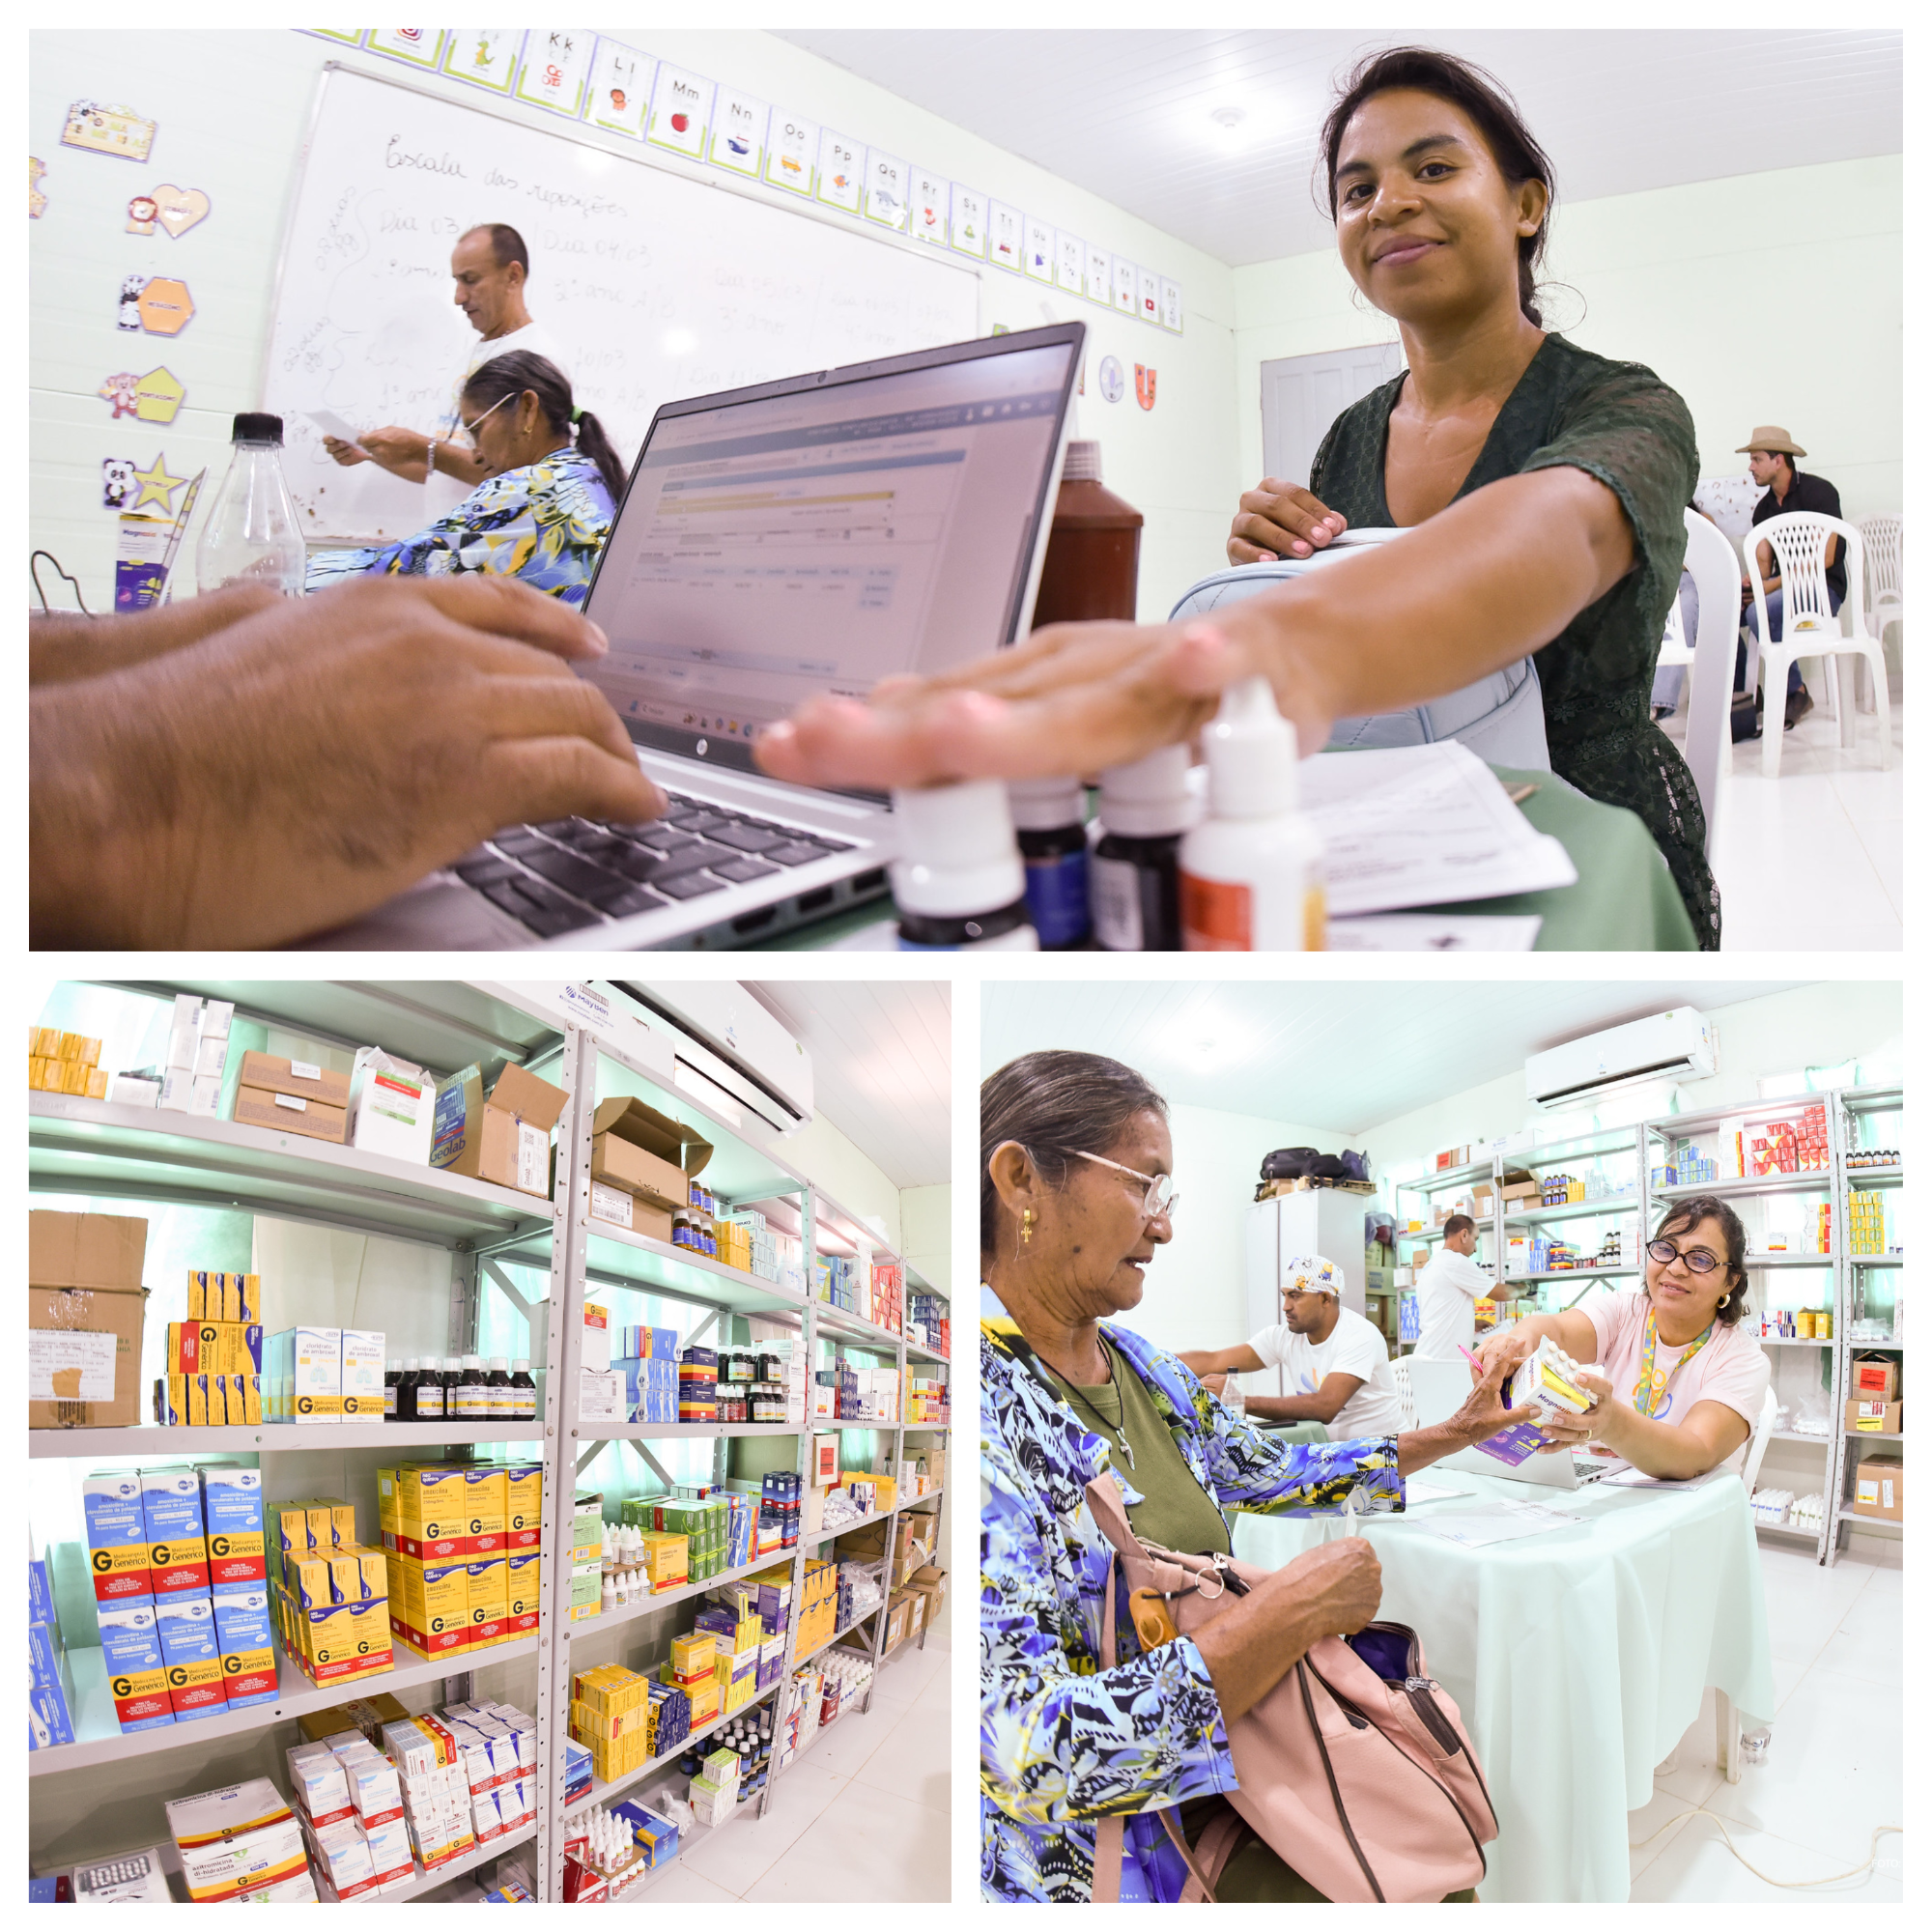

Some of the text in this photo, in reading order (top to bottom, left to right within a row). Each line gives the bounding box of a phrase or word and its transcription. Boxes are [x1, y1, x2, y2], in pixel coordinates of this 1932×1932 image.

[386, 133, 469, 180] Escala
[483, 167, 520, 191] das
[380, 209, 419, 235] Dia
[543, 230, 589, 256] Dia
[1134, 361, 1157, 412] U
[430, 1139, 466, 1163] Geolab
[201, 1327, 217, 1342] G
[298, 1396, 314, 1414] G
[343, 1397, 358, 1414] G
[469, 1519, 482, 1534] G
[512, 1515, 524, 1529] G
[426, 1522, 440, 1539] G
[212, 1536, 230, 1556] G
[231, 1545, 262, 1554] Genérico
[93, 1550, 112, 1572] G
[152, 1545, 170, 1565] G
[172, 1550, 204, 1561] Genérico
[114, 1557, 147, 1569] Genérico
[485, 1610, 504, 1619] Genérico
[513, 1601, 524, 1614] G
[472, 1608, 485, 1623] G
[431, 1617, 444, 1633] G
[444, 1619, 465, 1629] Genérico
[224, 1655, 242, 1674] G
[242, 1659, 272, 1670] Genérico
[131, 1675, 163, 1685] Medicamento
[169, 1667, 187, 1686] G
[188, 1670, 219, 1682] Genérico
[112, 1677, 131, 1697] G
[133, 1681, 165, 1692] Genérico
[172, 1793, 206, 1805] azitromicina
[192, 1858, 233, 1871] azitromicina
[193, 1863, 235, 1877] di-hidratada
